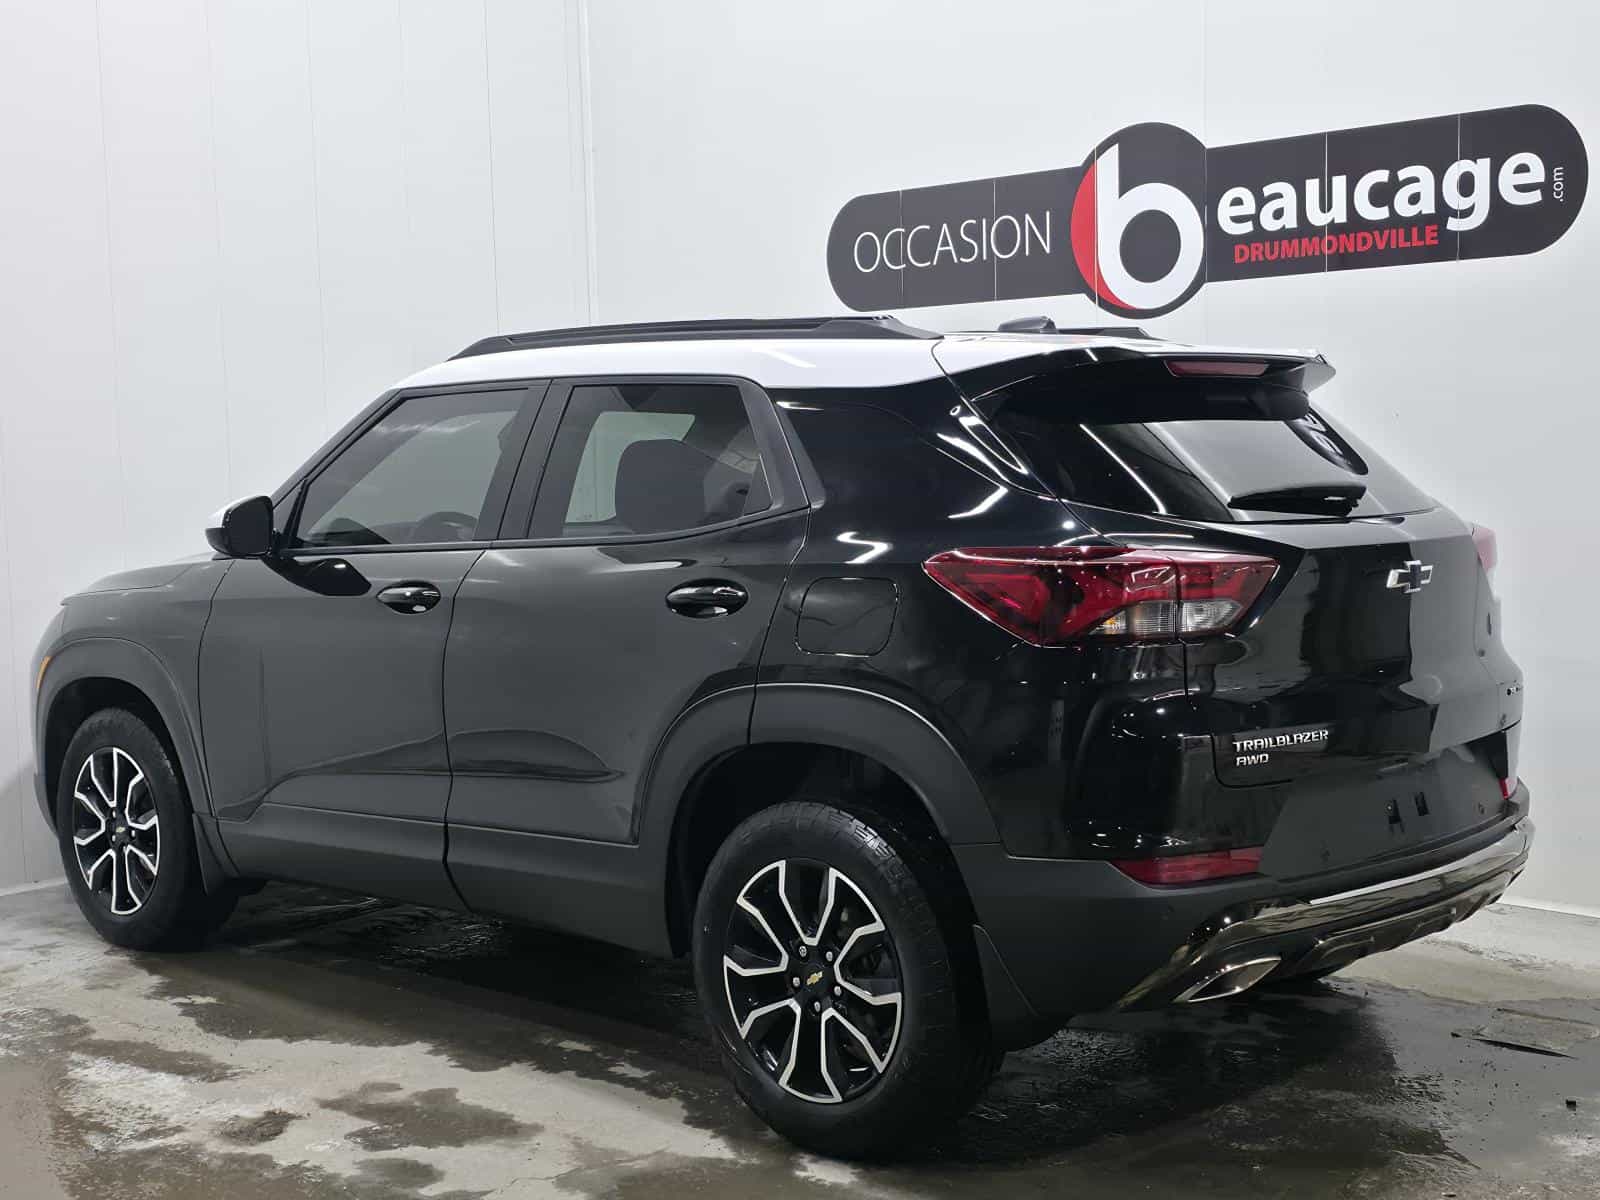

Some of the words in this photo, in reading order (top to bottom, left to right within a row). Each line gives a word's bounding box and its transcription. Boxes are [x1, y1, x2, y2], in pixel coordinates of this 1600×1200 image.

[853, 210, 1051, 273] OCCASION
[1233, 224, 1440, 264] DRUMMONDVILLE
[1233, 729, 1329, 752] TRAILBLAZER
[1236, 753, 1269, 766] AWD
